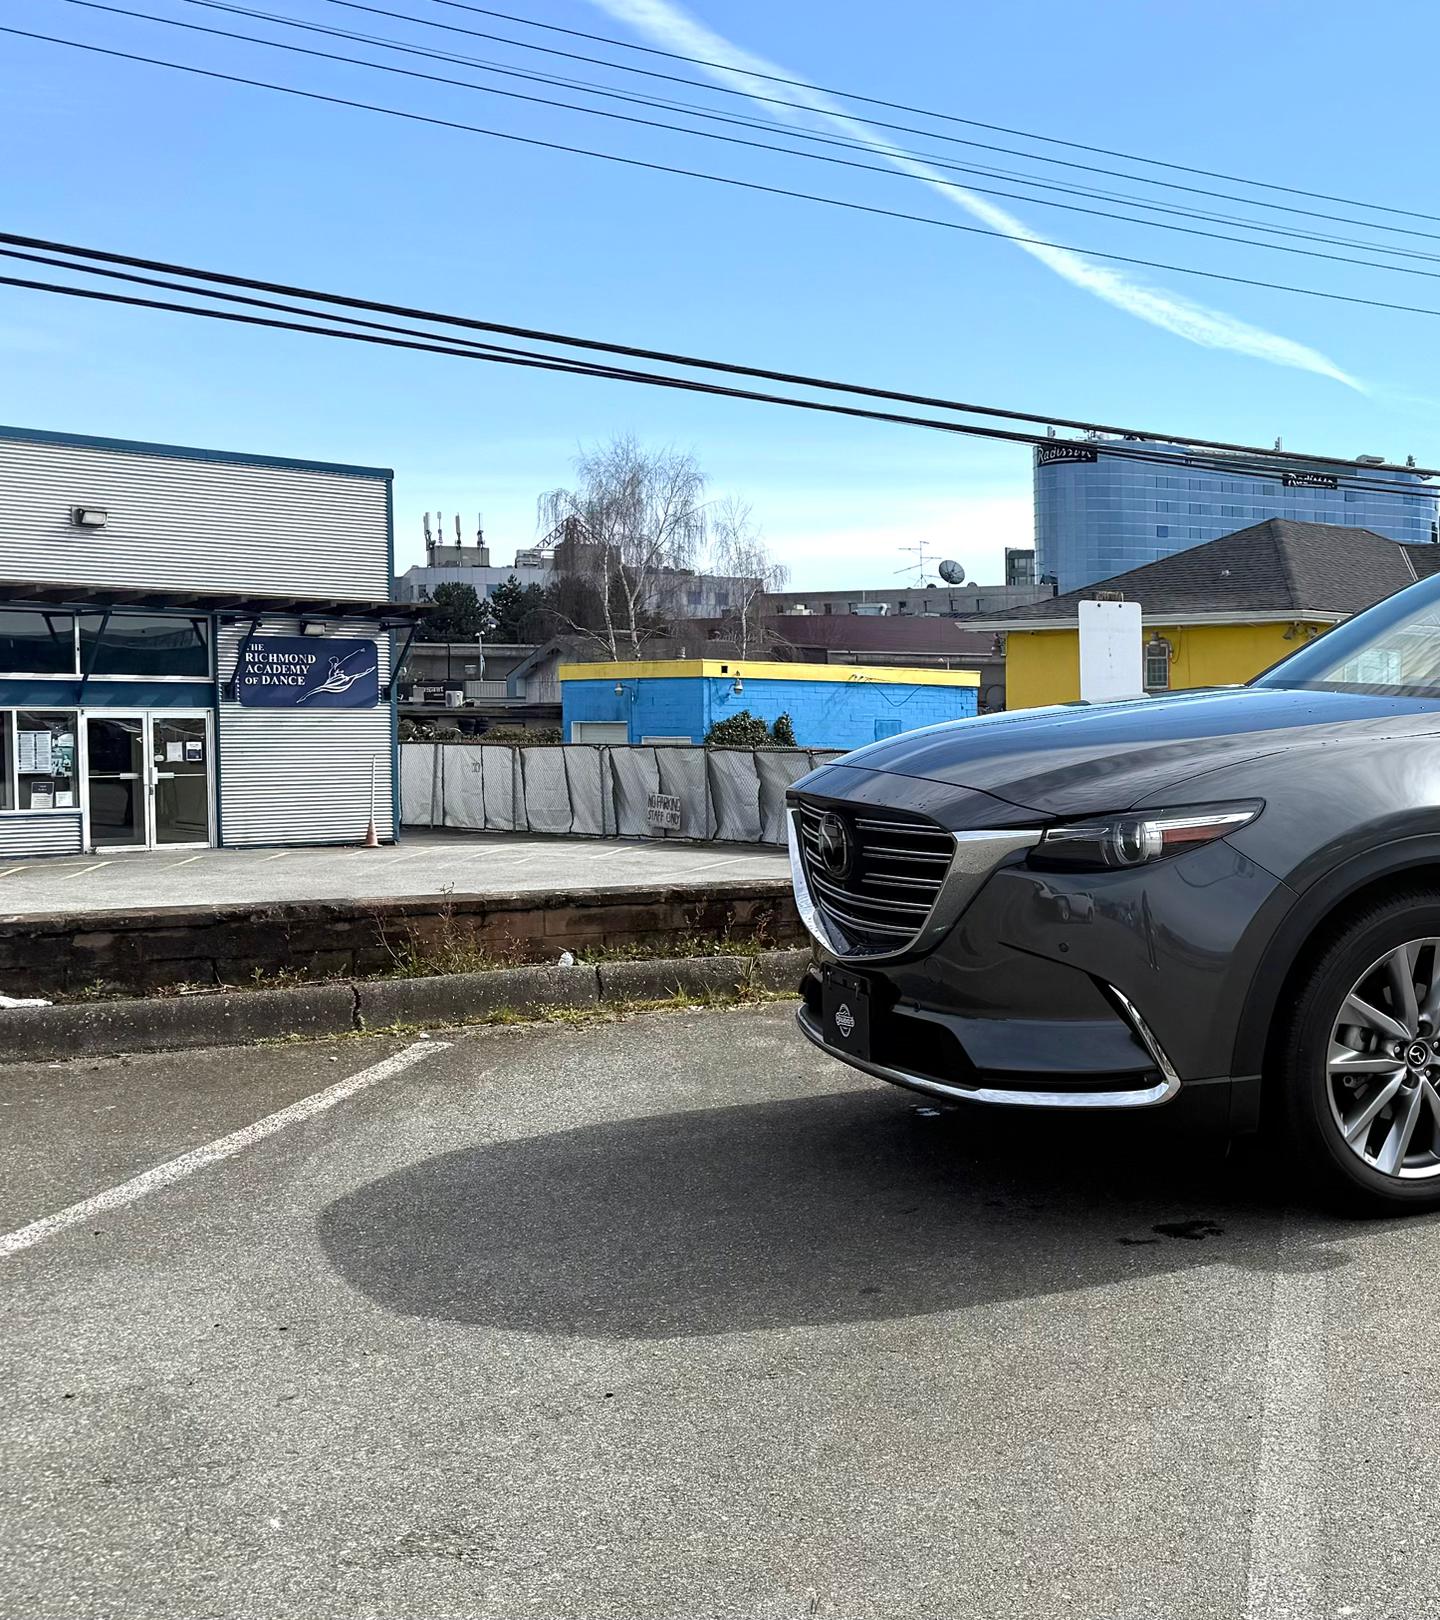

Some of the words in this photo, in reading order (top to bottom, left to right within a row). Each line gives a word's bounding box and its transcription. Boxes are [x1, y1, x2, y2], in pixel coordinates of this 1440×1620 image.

[245, 652, 317, 664] RICHMOND
[245, 663, 310, 675] ACADEMY
[244, 676, 259, 685] OF
[261, 675, 306, 686] DANCE
[648, 794, 656, 808] NO
[648, 809, 664, 821] STAFF
